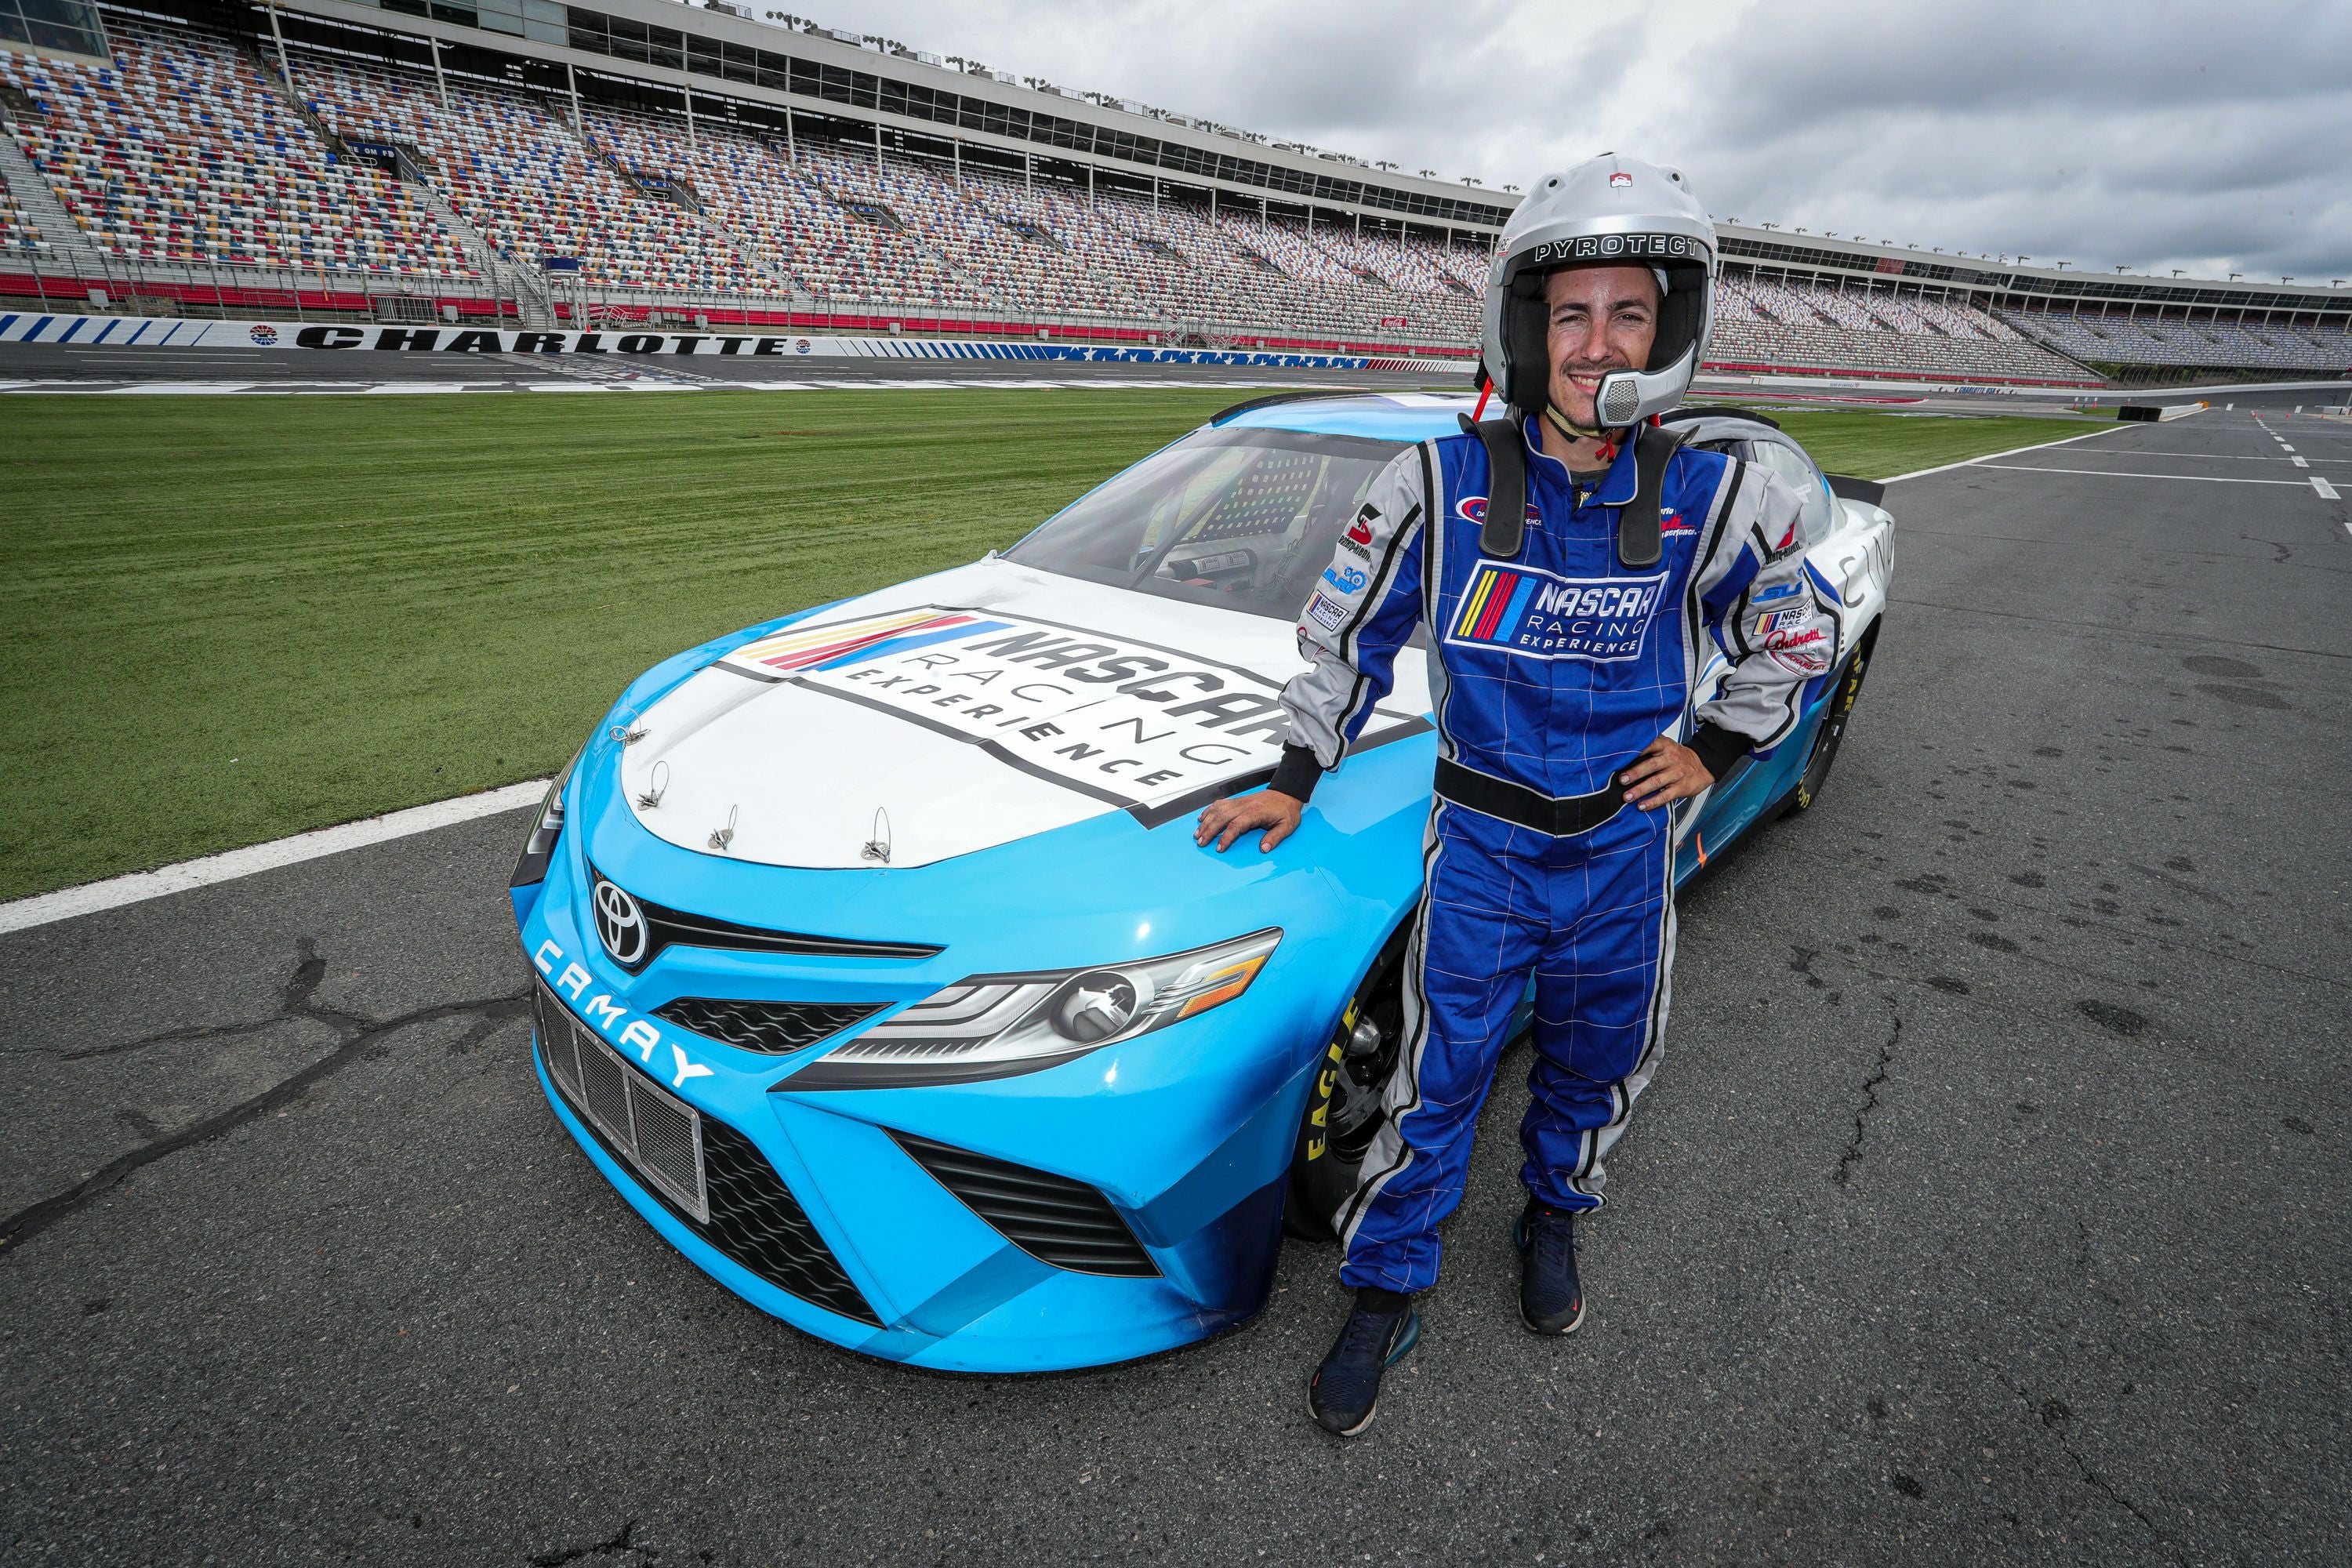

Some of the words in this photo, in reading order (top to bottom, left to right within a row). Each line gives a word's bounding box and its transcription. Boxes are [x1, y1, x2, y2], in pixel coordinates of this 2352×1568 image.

[1534, 235, 1698, 262] PYROTECT
[295, 326, 788, 356] CHARLOTTE
[1319, 597, 1344, 620] NASCAR
[1535, 583, 1657, 618] NASCAR
[1316, 607, 1337, 624] RACING
[1526, 615, 1644, 637] RACING
[1520, 633, 1638, 654] EXPERIENCE
[902, 653, 1252, 766] RACING
[845, 669, 1184, 786] EXPERIENCE
